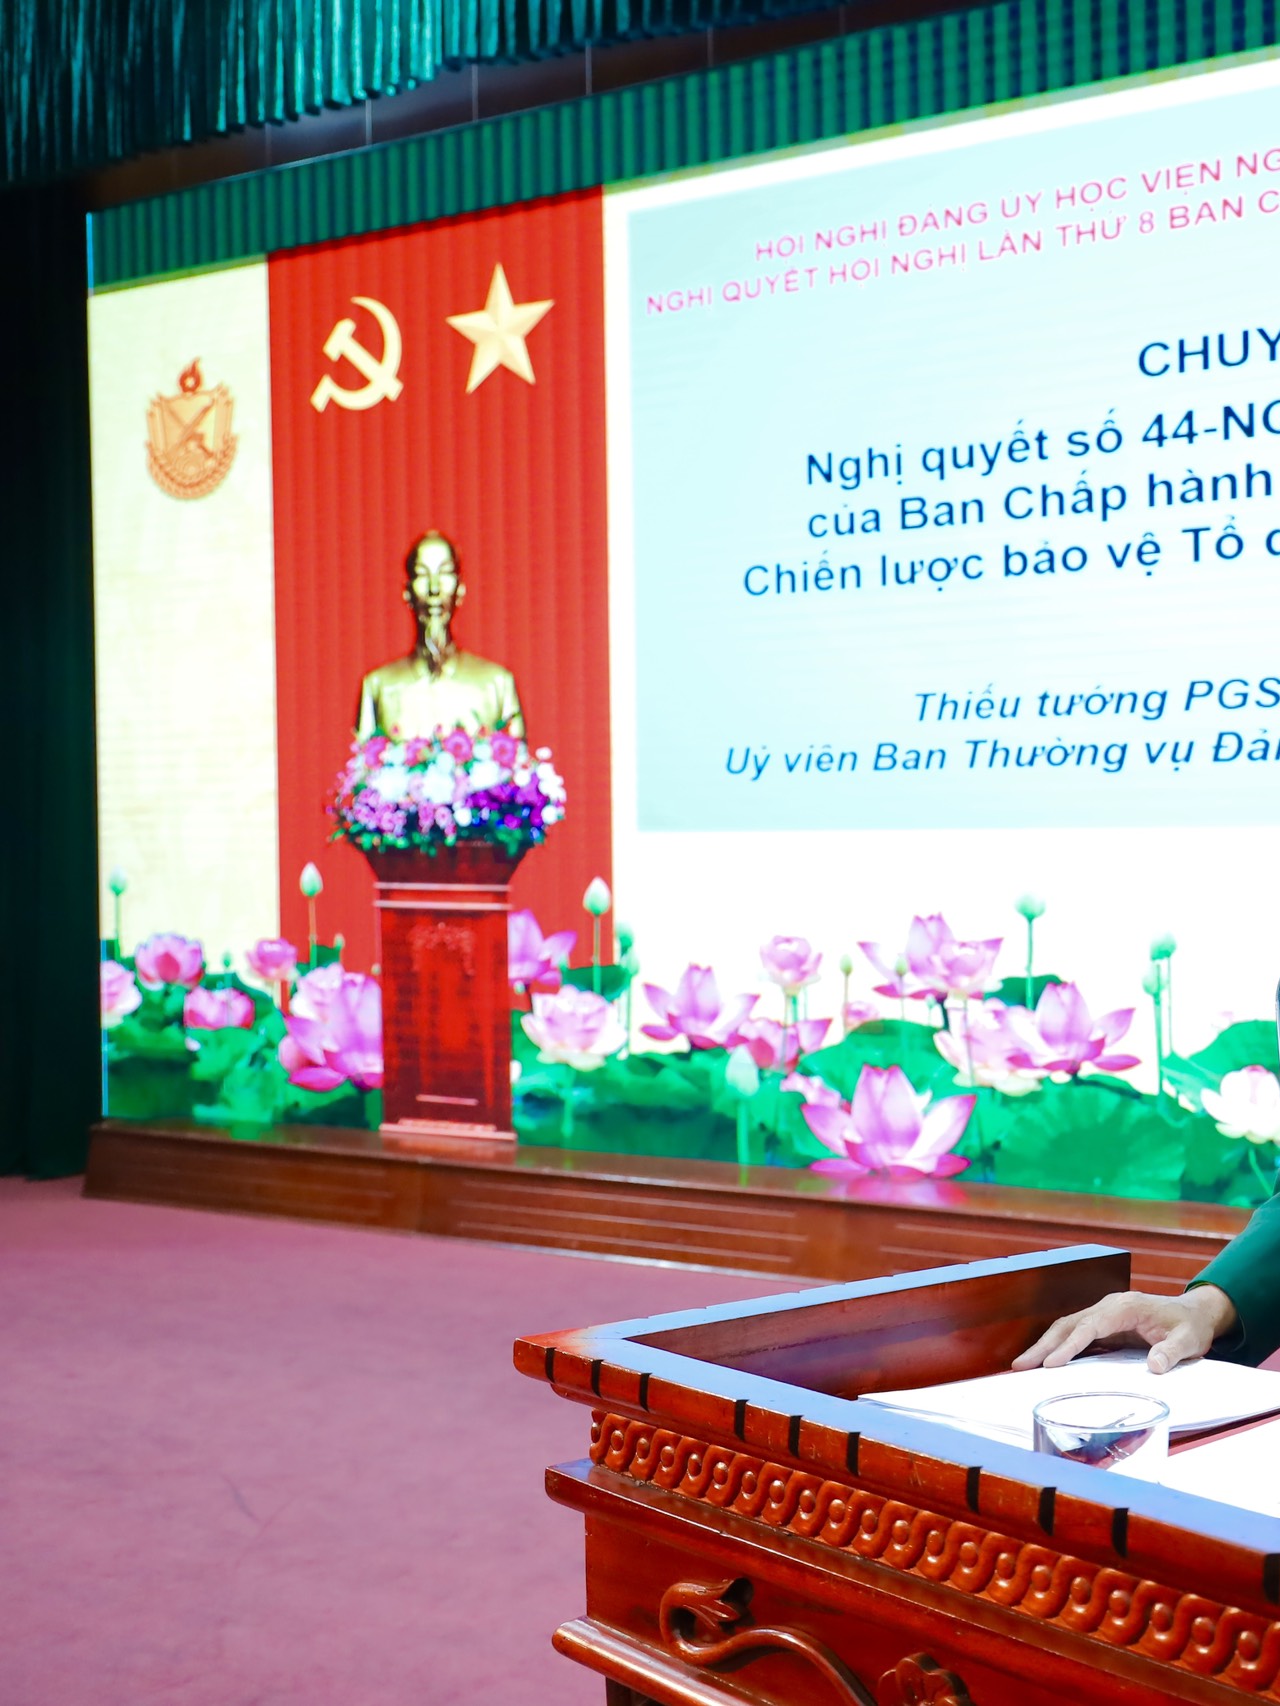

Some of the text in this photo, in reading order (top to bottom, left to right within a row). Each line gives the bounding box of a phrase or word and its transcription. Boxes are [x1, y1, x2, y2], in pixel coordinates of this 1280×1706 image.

[898, 202, 988, 236] ĐẢNG
[1056, 177, 1127, 211] HỌC
[1139, 212, 1154, 234] 8
[1169, 196, 1243, 229] BAN
[807, 443, 902, 491] Nghị
[921, 419, 1049, 481] quyết
[1067, 408, 1123, 457] số
[808, 505, 881, 538] của
[900, 496, 984, 530] Ban
[1004, 470, 1127, 522] Chấp
[1148, 462, 1272, 508] hành
[743, 550, 862, 596] Chiến
[881, 554, 984, 592] lược
[1003, 541, 1088, 578] bảo
[1107, 532, 1161, 576] vệ
[1181, 515, 1244, 563] Tổ
[915, 684, 1021, 721] Thiếu
[1038, 685, 1168, 721] tướng
[784, 745, 858, 773] viên
[873, 742, 946, 771] Ban
[965, 737, 1128, 773] Thường
[1145, 741, 1195, 772] vụ
